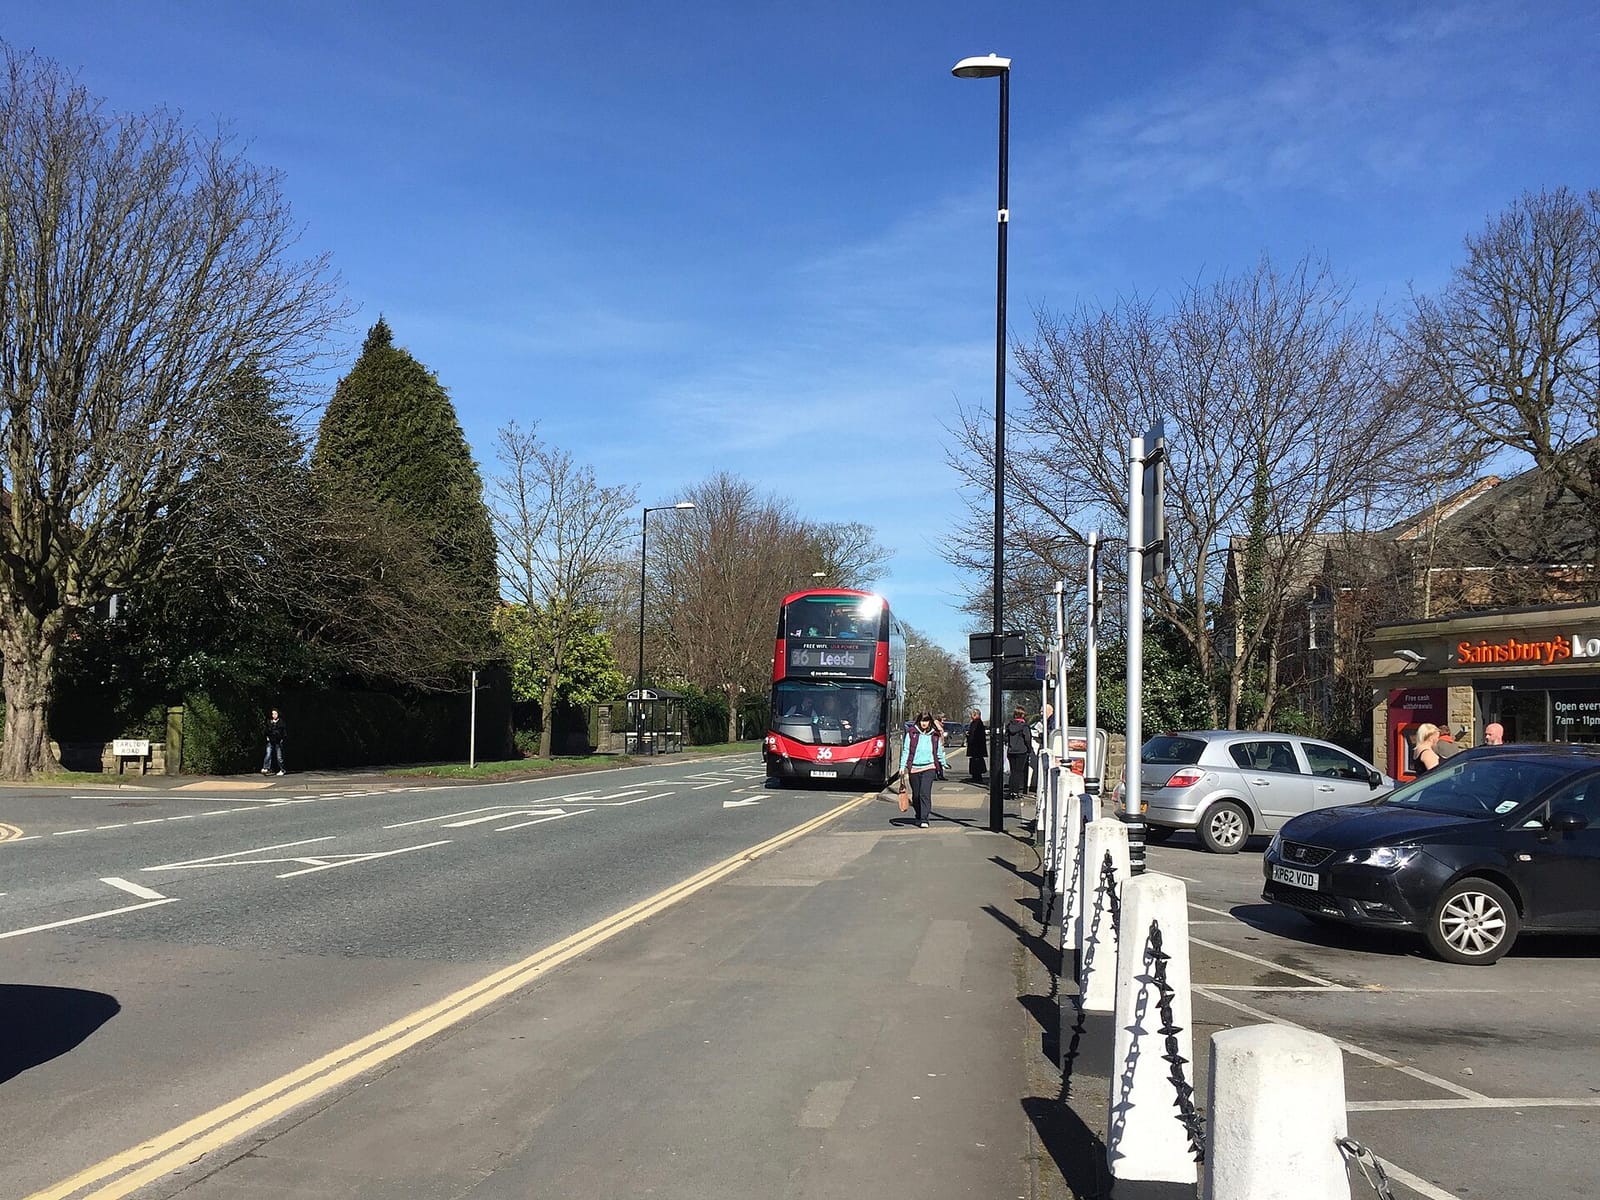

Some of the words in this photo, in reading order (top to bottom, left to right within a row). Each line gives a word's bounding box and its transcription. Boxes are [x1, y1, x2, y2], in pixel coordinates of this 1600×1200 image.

[792, 649, 809, 666] 36
[820, 651, 855, 666] Leeds
[1457, 635, 1571, 665] Sainsbury's
[1555, 701, 1577, 713] Open
[1578, 702, 1600, 713] ever
[1555, 715, 1574, 725] 7am
[816, 746, 832, 760] 36
[1296, 871, 1314, 887] VOD
